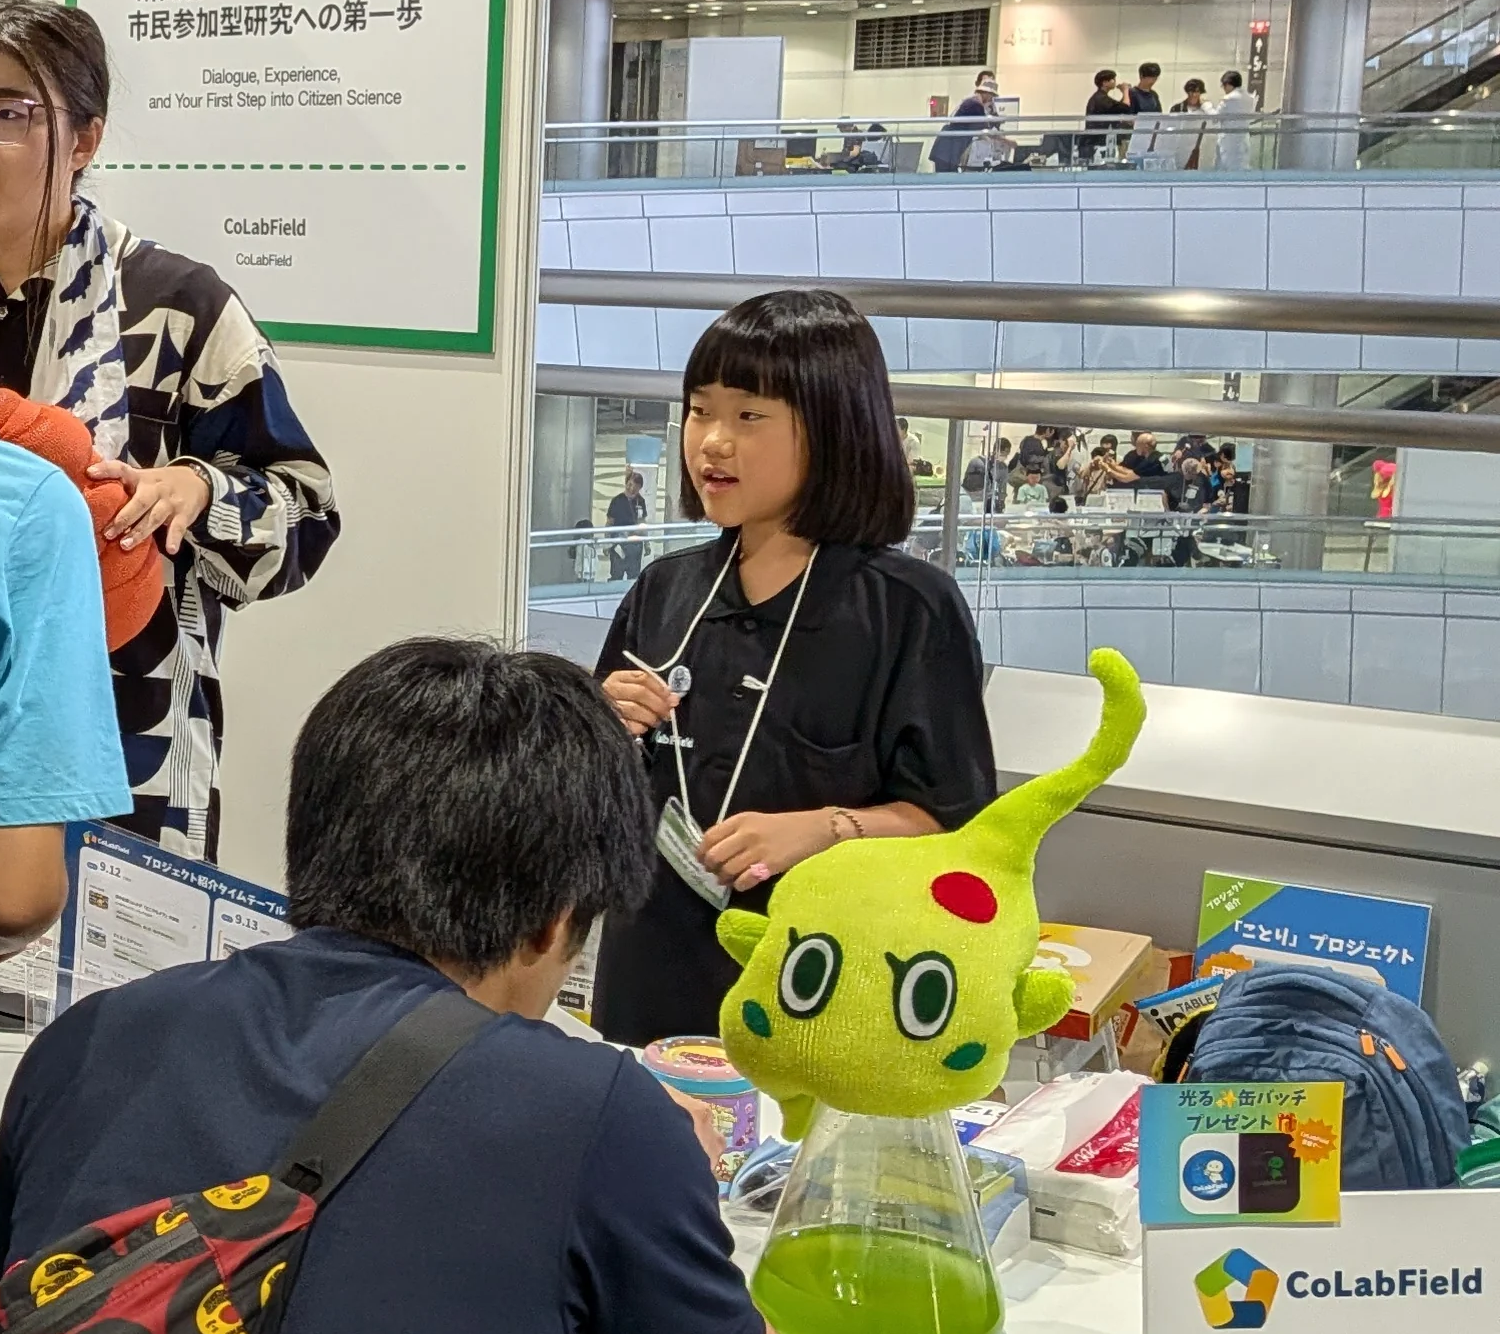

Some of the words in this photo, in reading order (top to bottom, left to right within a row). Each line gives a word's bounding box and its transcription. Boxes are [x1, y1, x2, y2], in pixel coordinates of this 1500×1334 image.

[202, 67, 260, 87] Dialogue,
[264, 66, 341, 86] Experience,
[149, 94, 172, 109] and
[175, 93, 203, 108] Your
[206, 92, 233, 107] First
[237, 91, 267, 110] Step
[270, 91, 294, 107] into
[298, 90, 342, 107] Citizen
[347, 88, 402, 105] Science
[223, 218, 306, 236] CoLabField
[235, 252, 293, 267] CoLabField
[99, 861, 122, 879] 9.12
[1206, 881, 1245, 910] プロジェクト
[235, 914, 259, 931] 9.13
[1178, 1089, 1214, 1107] 光る
[1186, 1113, 1273, 1131] プレゼント
[1286, 1267, 1483, 1299] CoLabField
